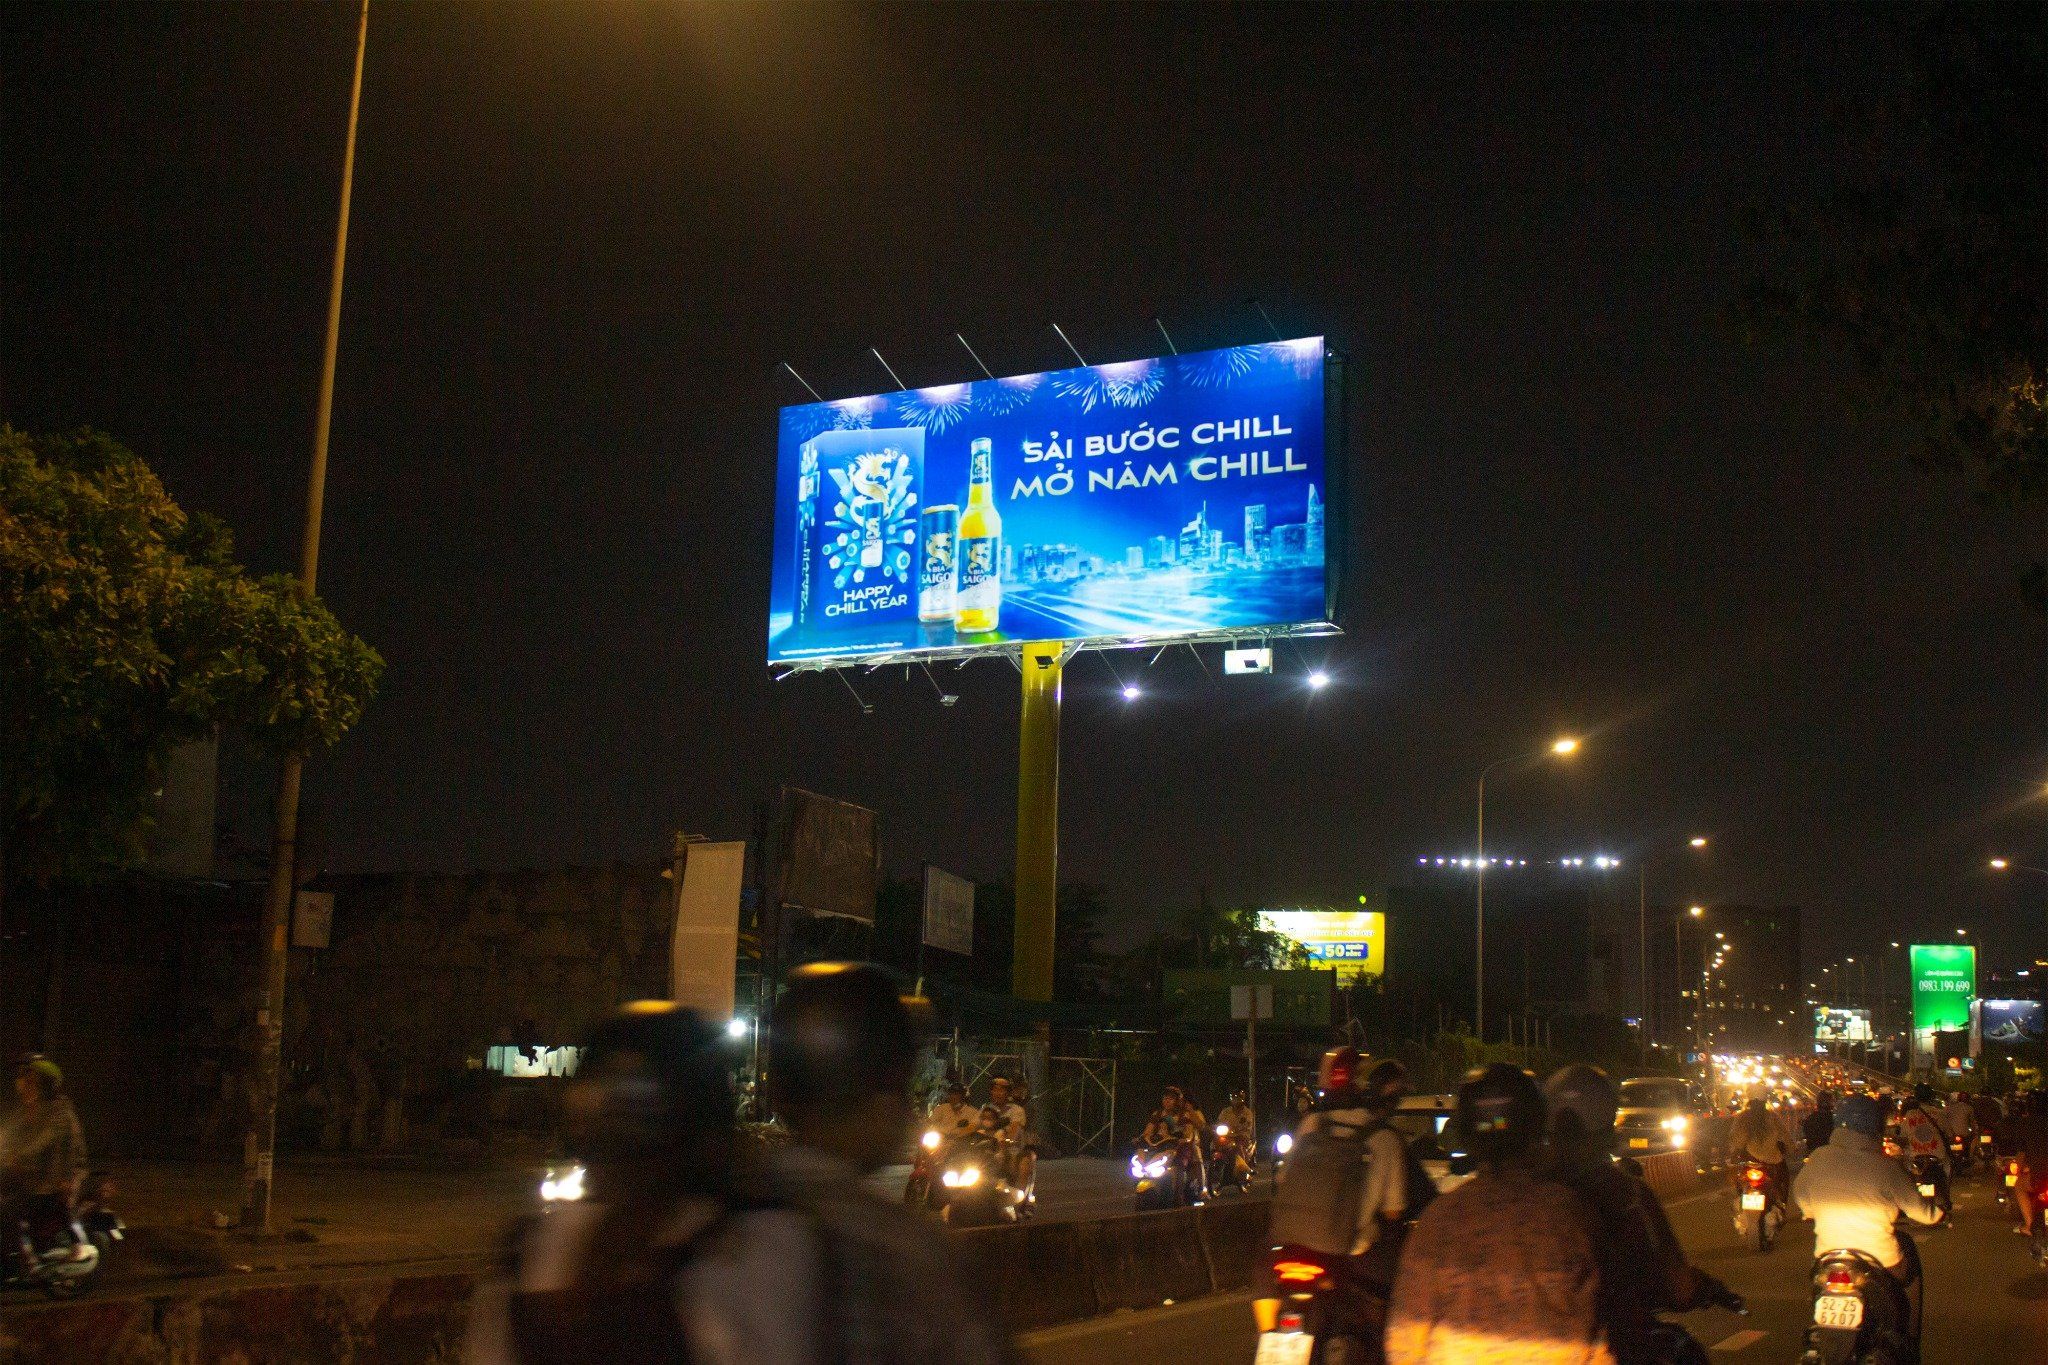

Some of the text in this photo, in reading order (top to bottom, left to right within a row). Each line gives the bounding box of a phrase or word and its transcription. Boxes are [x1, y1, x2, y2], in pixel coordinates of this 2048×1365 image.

[1024, 415, 1292, 464] SẢI BƯỚC CHILL
[1010, 448, 1307, 500] MỞ NĂM CHILL
[825, 593, 907, 617] CHILL YEAR
[843, 584, 894, 602] HAPPY
[1325, 944, 1345, 958] 50
